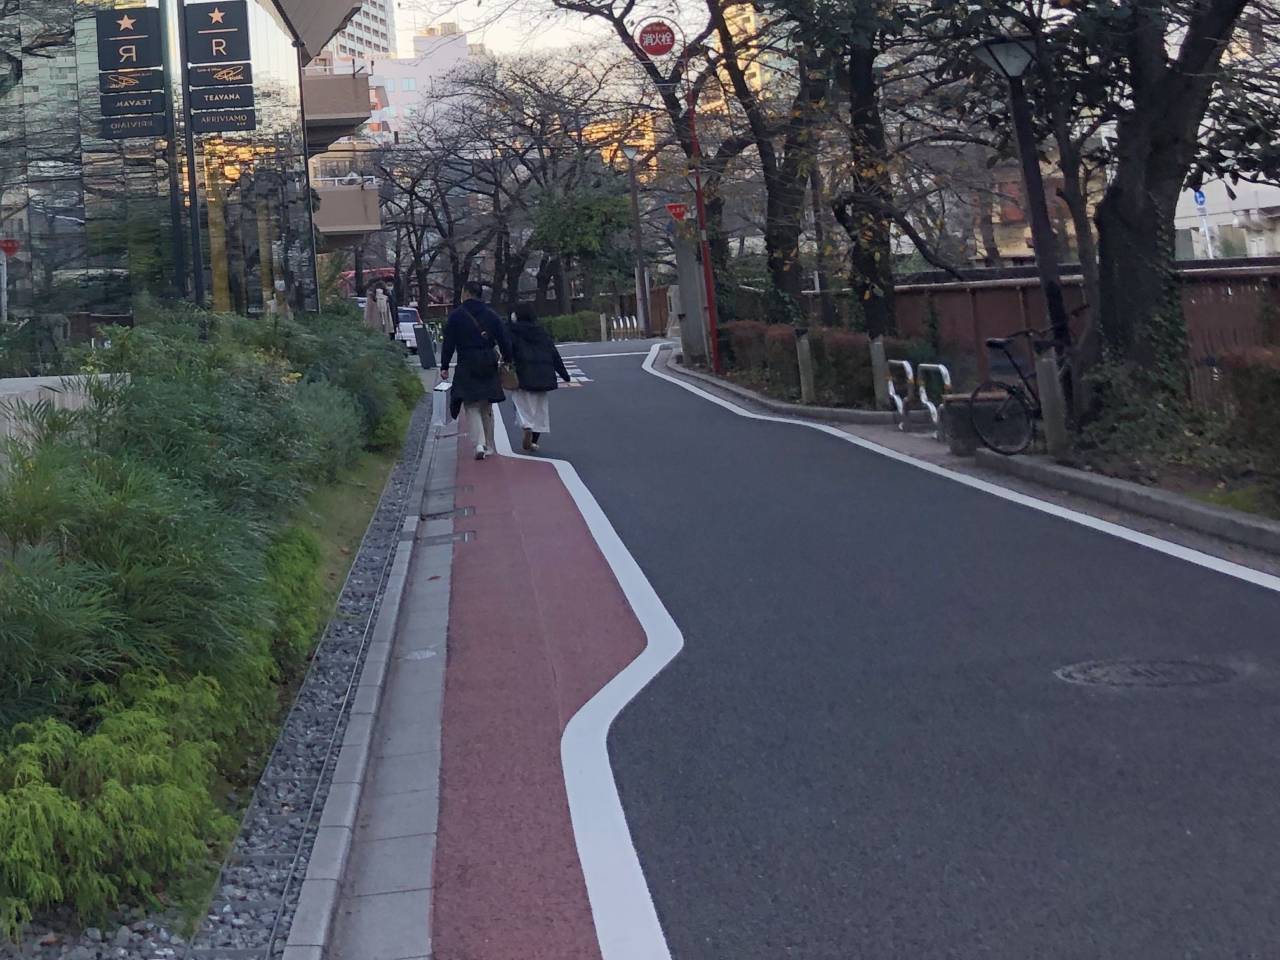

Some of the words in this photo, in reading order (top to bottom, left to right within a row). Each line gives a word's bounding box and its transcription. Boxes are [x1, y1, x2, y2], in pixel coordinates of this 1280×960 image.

[642, 32, 672, 46] 消火栓
[212, 39, 227, 56] R
[204, 93, 240, 101] TEAVANA
